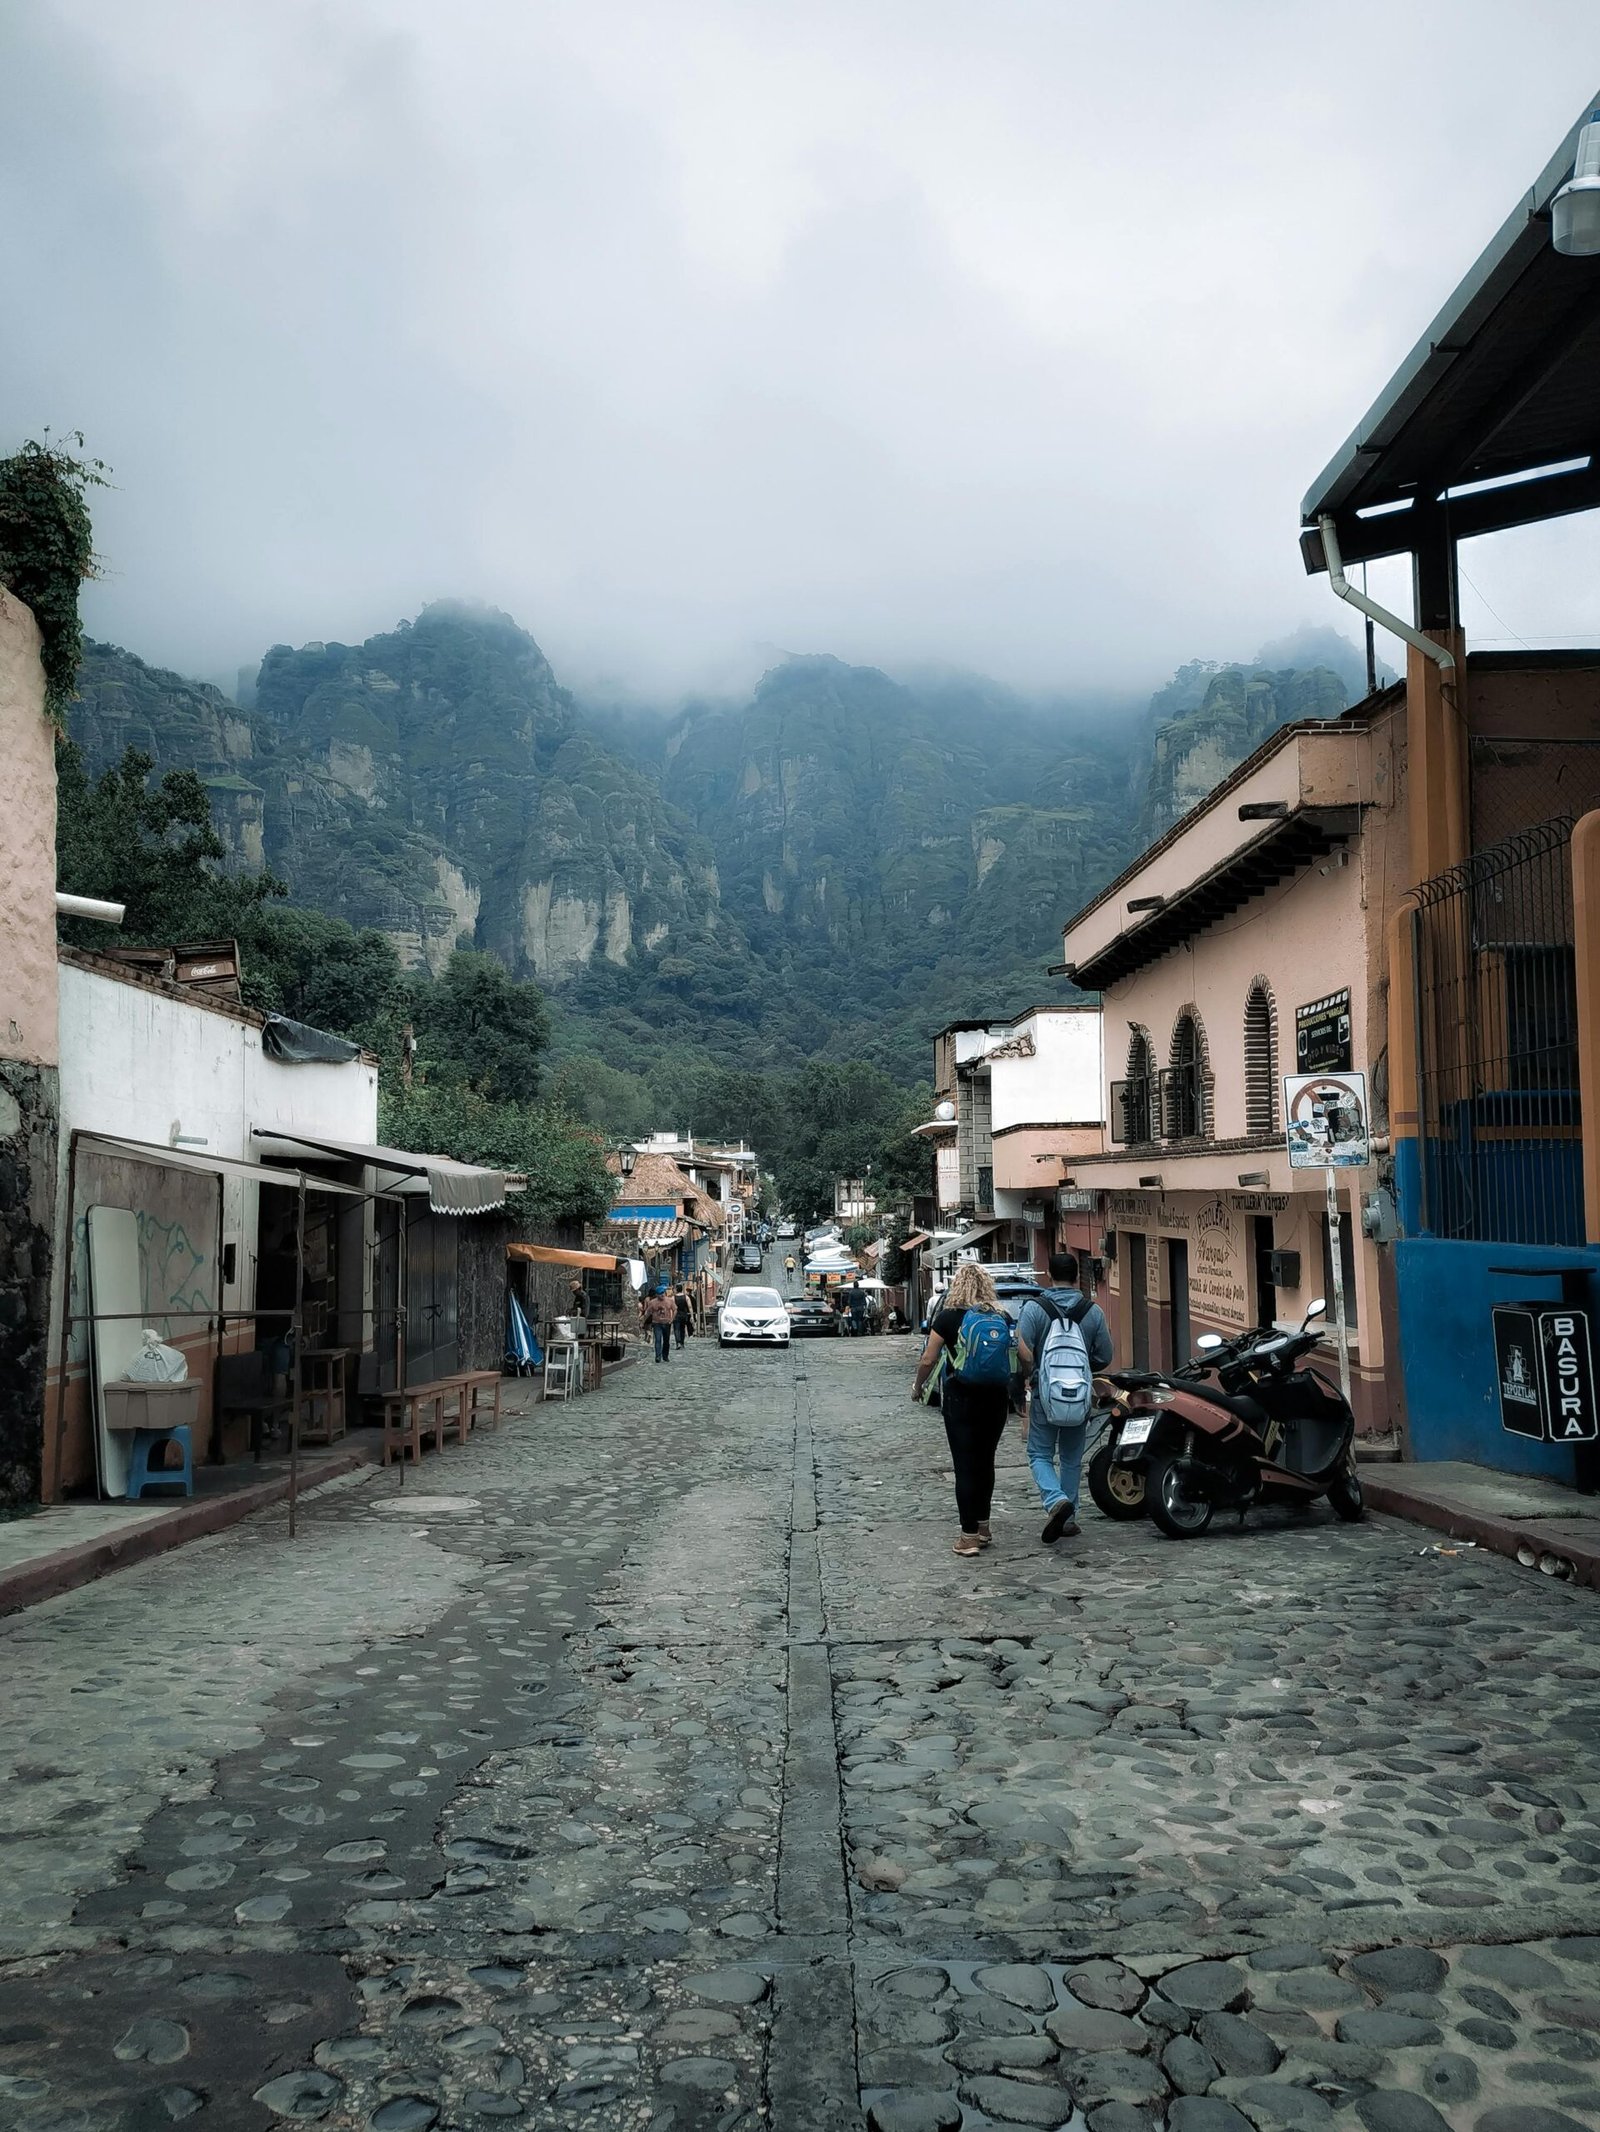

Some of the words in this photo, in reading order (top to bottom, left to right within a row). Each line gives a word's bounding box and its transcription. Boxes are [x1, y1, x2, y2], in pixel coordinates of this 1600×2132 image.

[1299, 1012, 1327, 1029] PRODUCCIONES
[1325, 1044, 1345, 1058] VIDEO
[1554, 1317, 1584, 1436] BASURA
